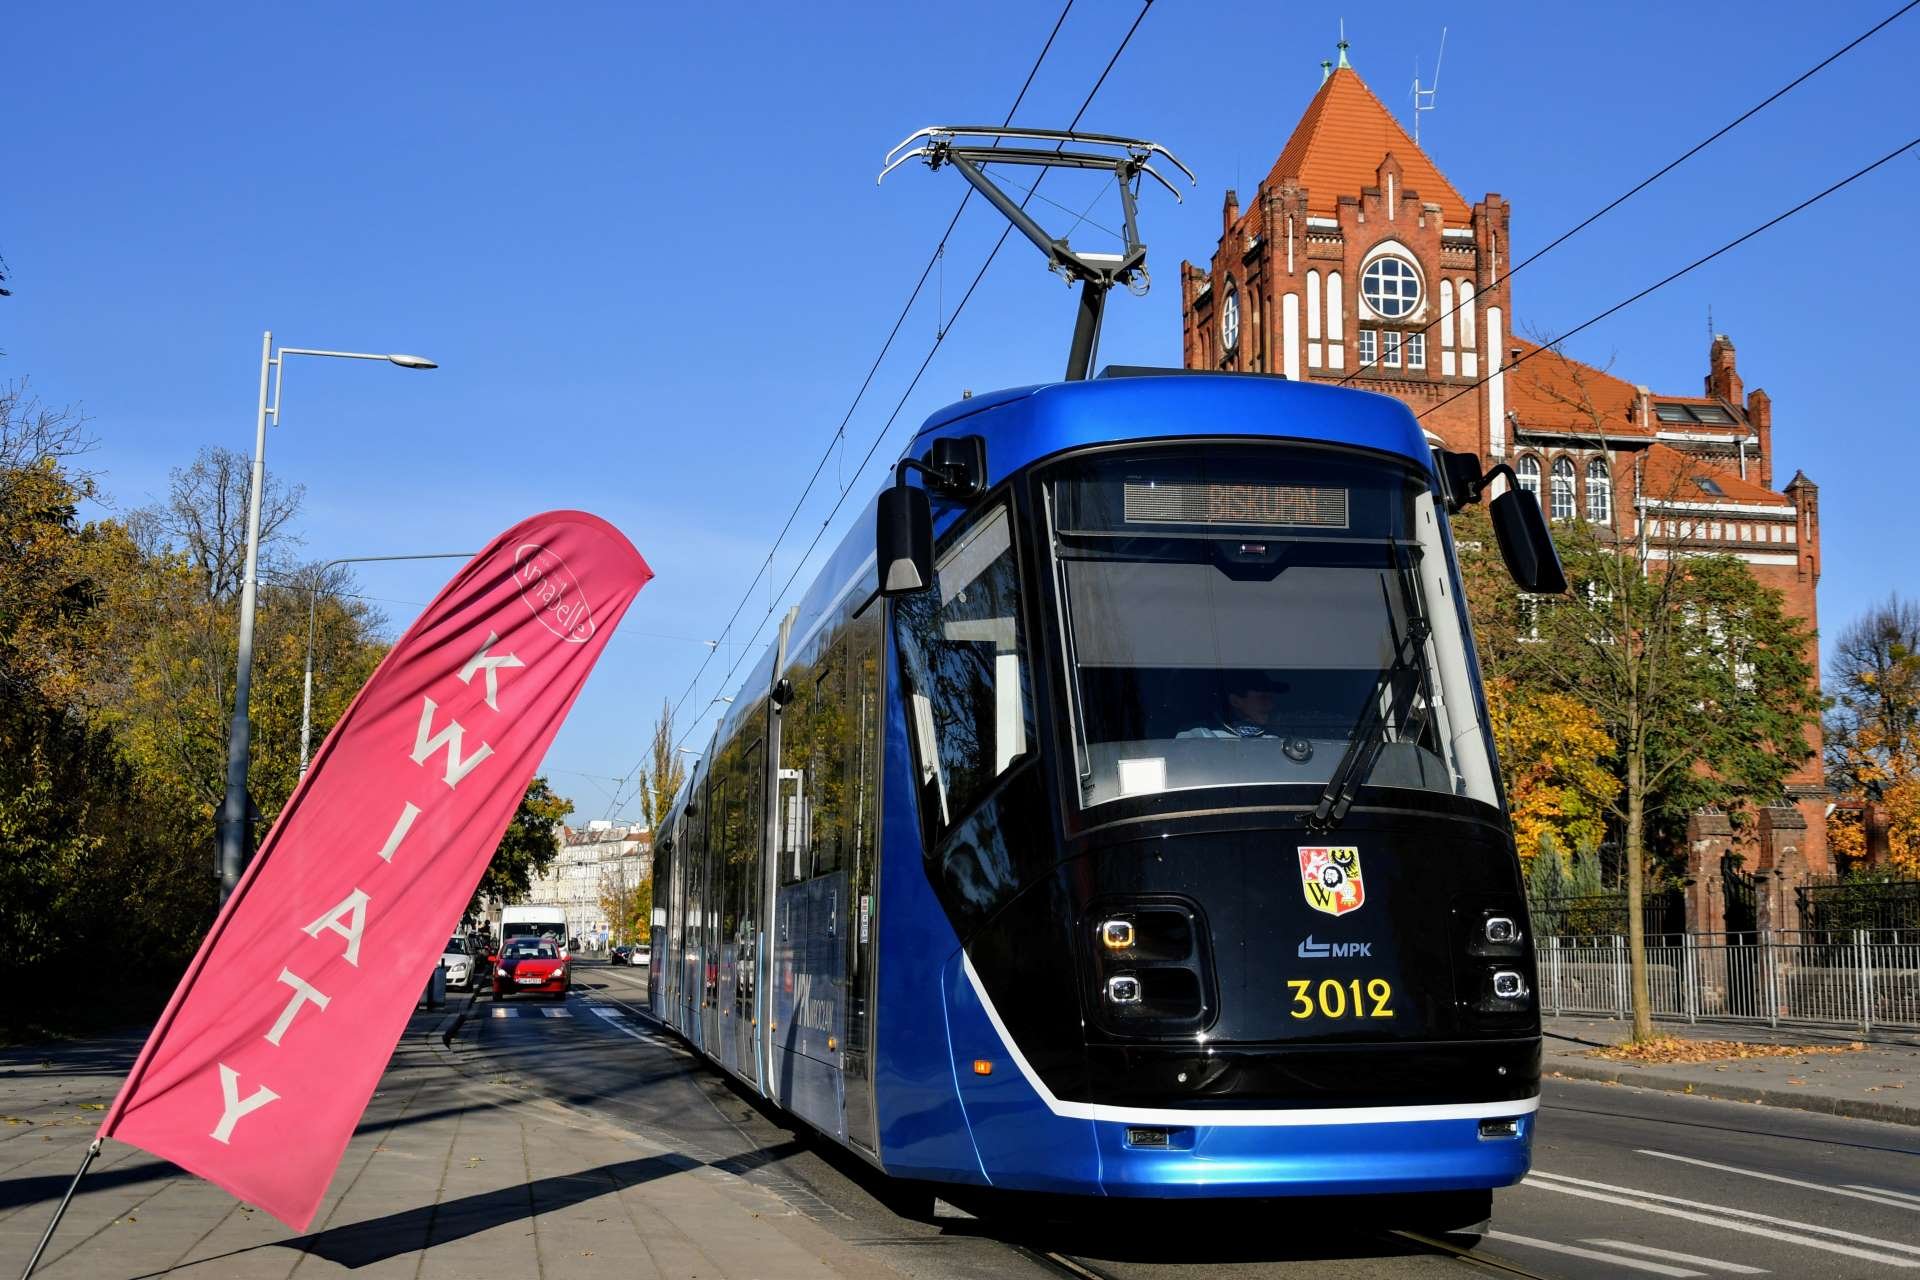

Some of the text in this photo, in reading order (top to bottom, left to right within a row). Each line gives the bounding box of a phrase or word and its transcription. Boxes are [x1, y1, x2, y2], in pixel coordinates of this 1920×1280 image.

[1209, 484, 1318, 522] BISKUPIN
[209, 631, 525, 1145] KWIATY
[1332, 942, 1372, 957] MPK
[1287, 978, 1394, 1019] 3012
